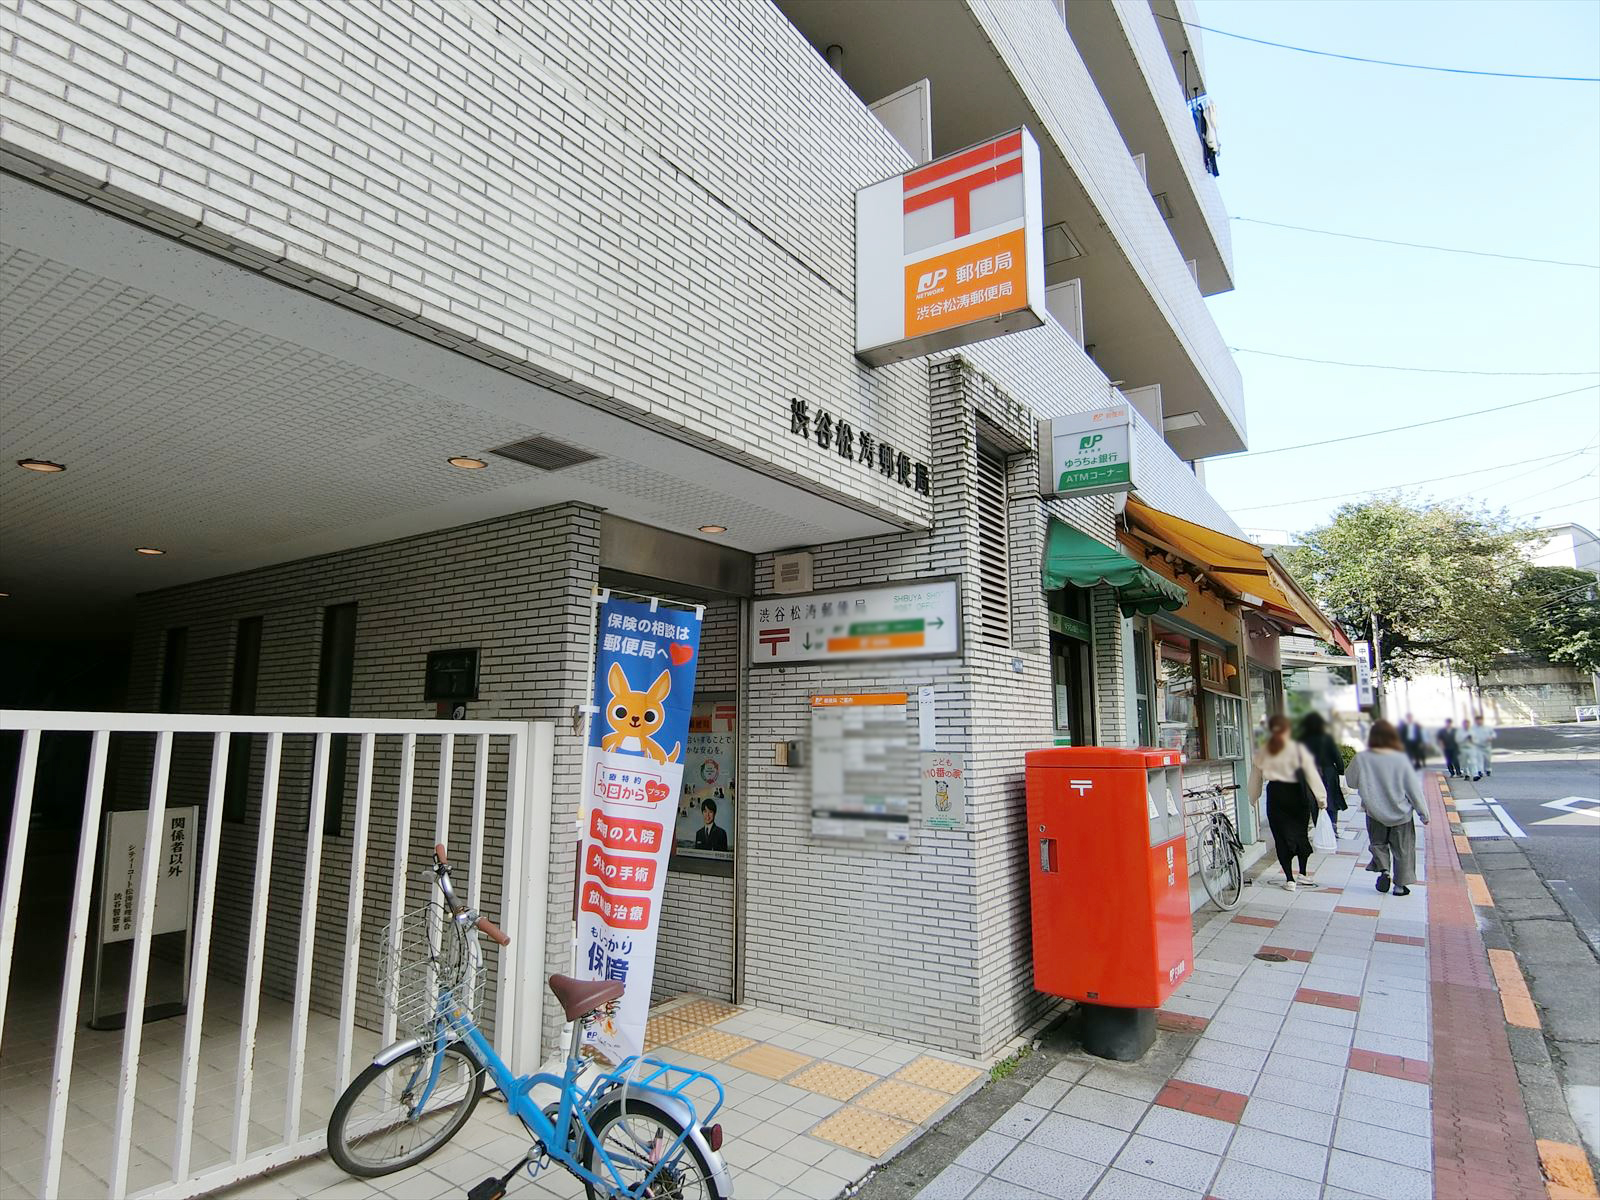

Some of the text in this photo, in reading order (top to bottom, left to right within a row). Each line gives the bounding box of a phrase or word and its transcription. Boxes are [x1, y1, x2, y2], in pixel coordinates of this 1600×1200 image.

[917, 251, 1013, 293] JP 郵便局
[915, 286, 945, 300] NETWORK
[916, 281, 1013, 320] 渋谷松涛郵便局
[790, 397, 930, 497] 渋谷松涛郵便局
[1079, 434, 1103, 450] JP
[1064, 451, 1118, 469] ゆうちょ銀行
[1066, 468, 1124, 483] ATMコーナー
[607, 612, 690, 640] 保険の相談は
[602, 633, 669, 659] 郵便局へ
[932, 758, 953, 767] こども
[648, 788, 666, 798] プラス
[168, 817, 186, 877] 関係者以外
